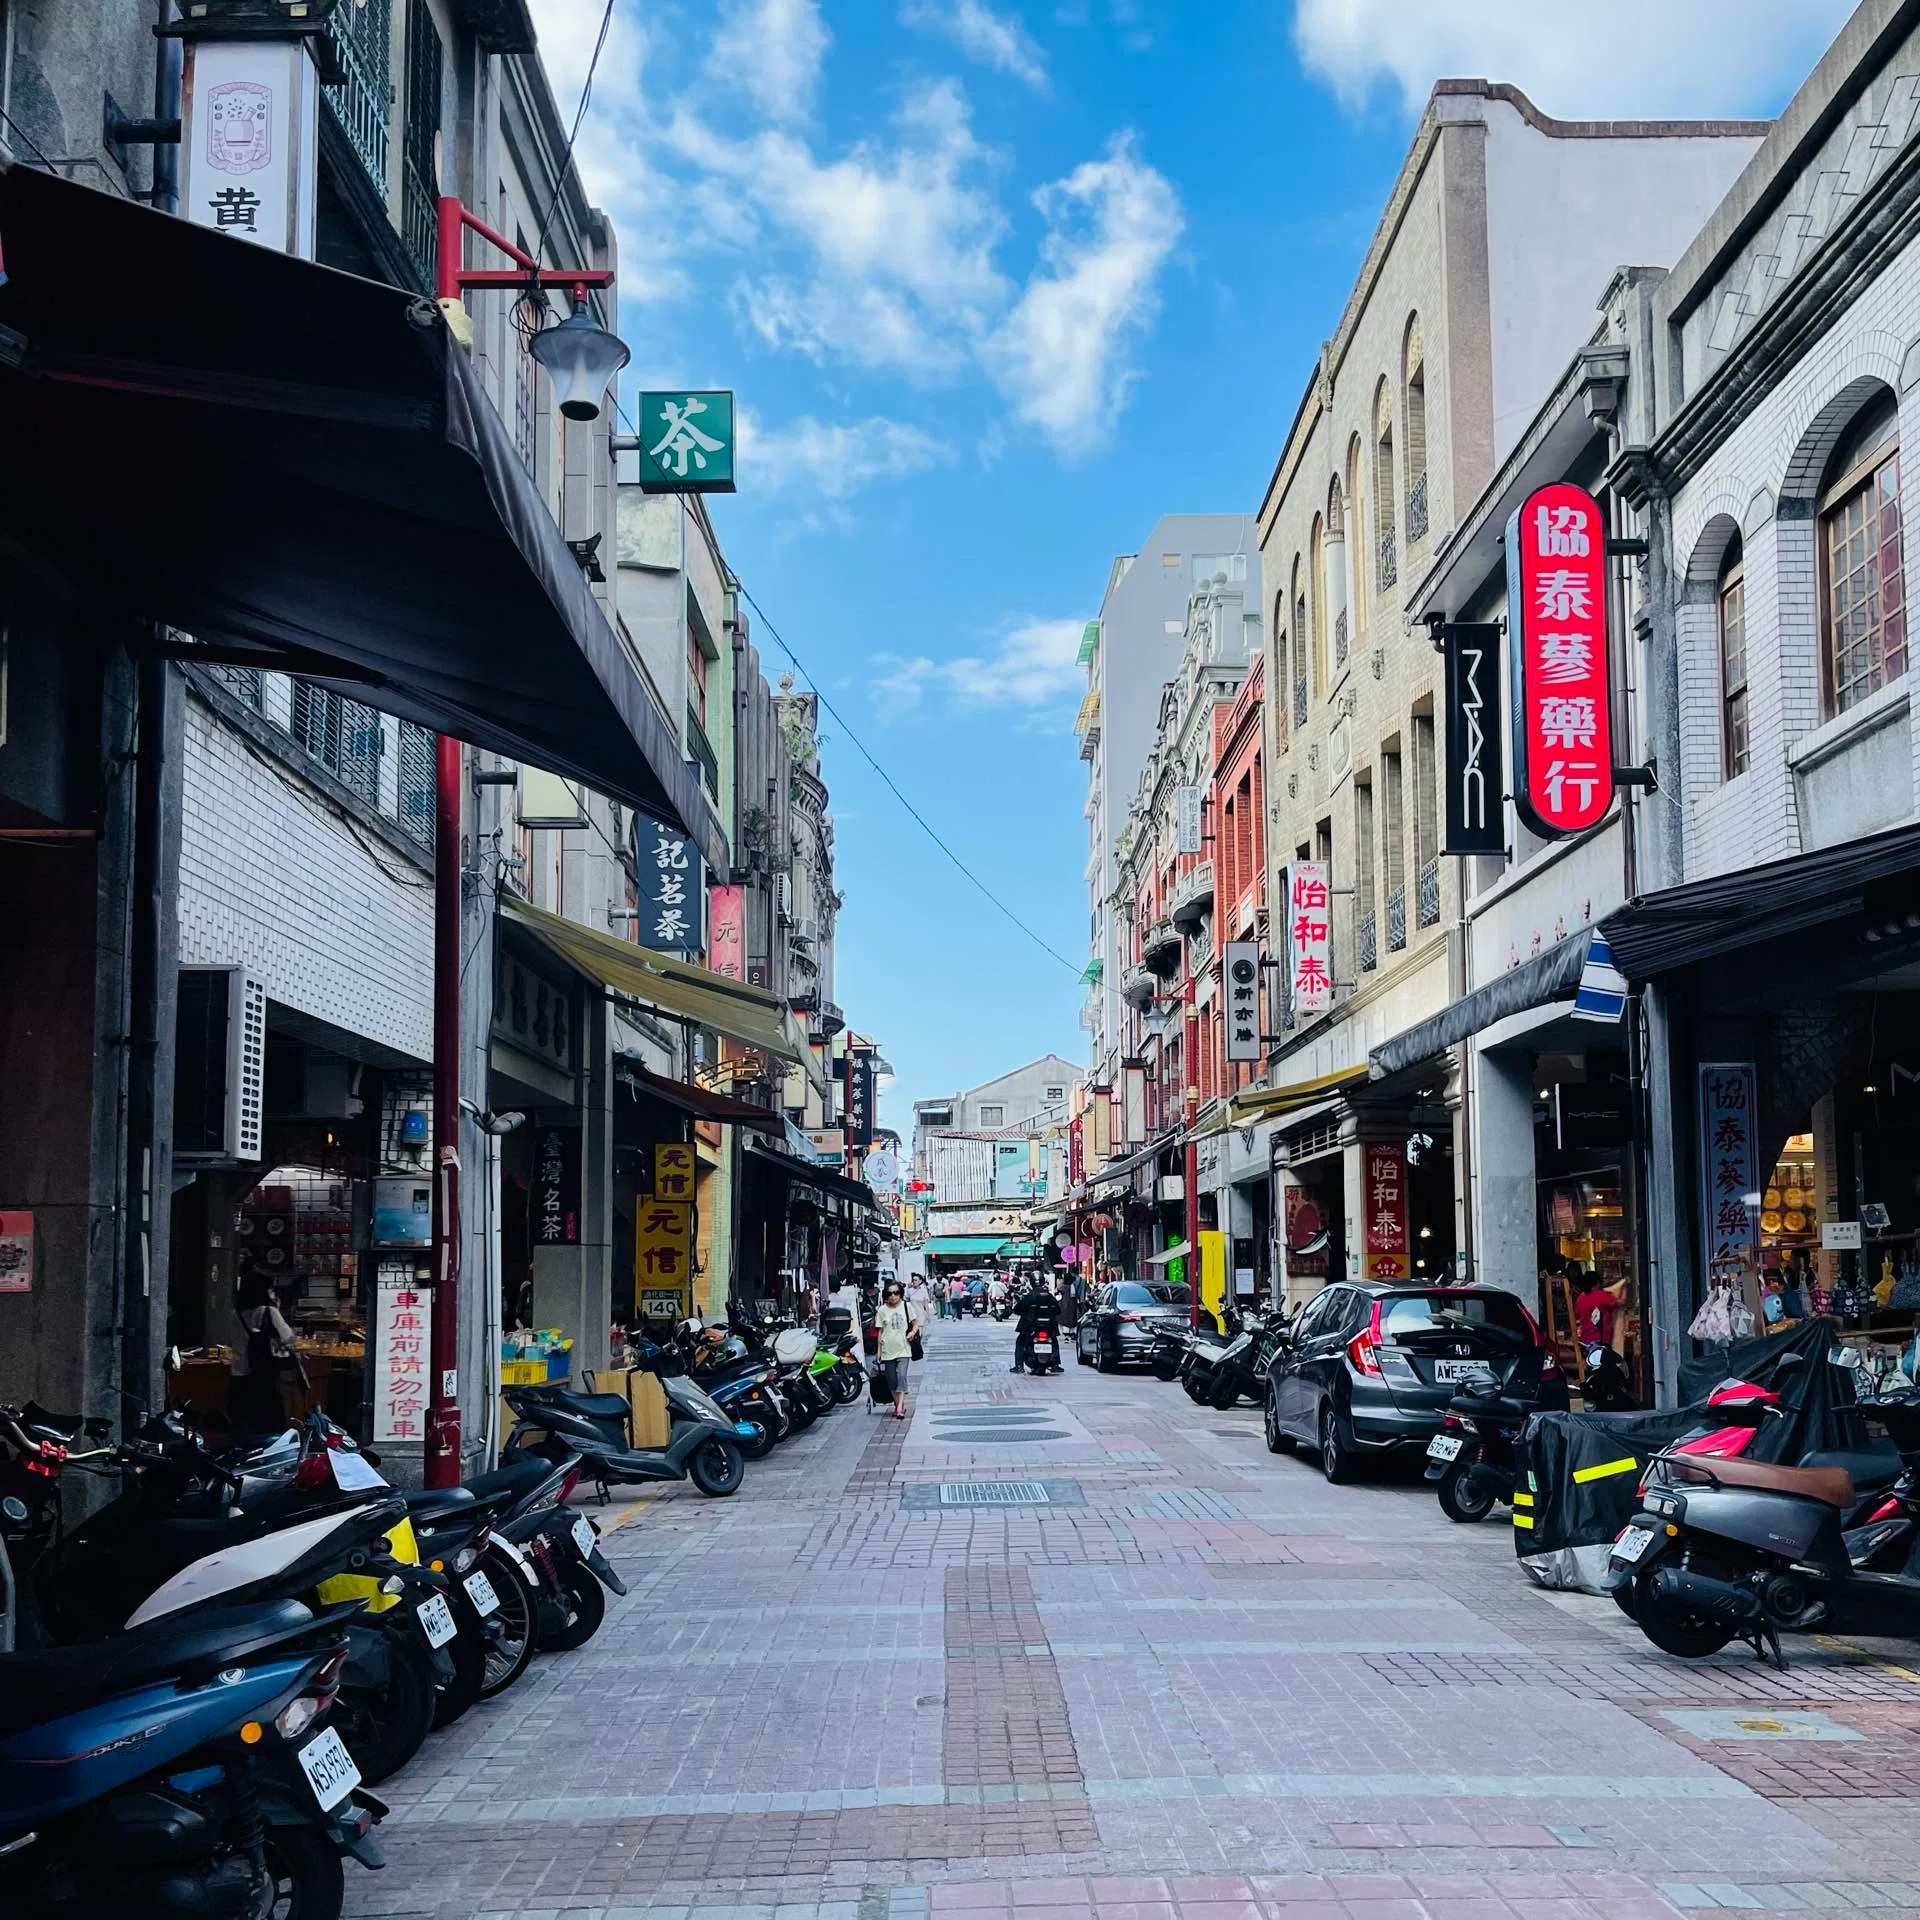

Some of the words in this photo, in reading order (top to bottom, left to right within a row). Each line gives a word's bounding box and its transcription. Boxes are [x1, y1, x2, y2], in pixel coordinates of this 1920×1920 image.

[650, 398, 725, 476] 茶
[1534, 506, 1599, 813] 協泰蔘藥行
[1294, 876, 1330, 995] 怡和泰
[541, 1132, 564, 1240] 臺灣名茶
[660, 1149, 690, 1194] 元信
[1372, 1158, 1402, 1236] 怡和泰
[643, 1208, 684, 1274] 元信
[648, 1302, 676, 1314] 140
[389, 1291, 425, 1439] 車庫前請勿停車
